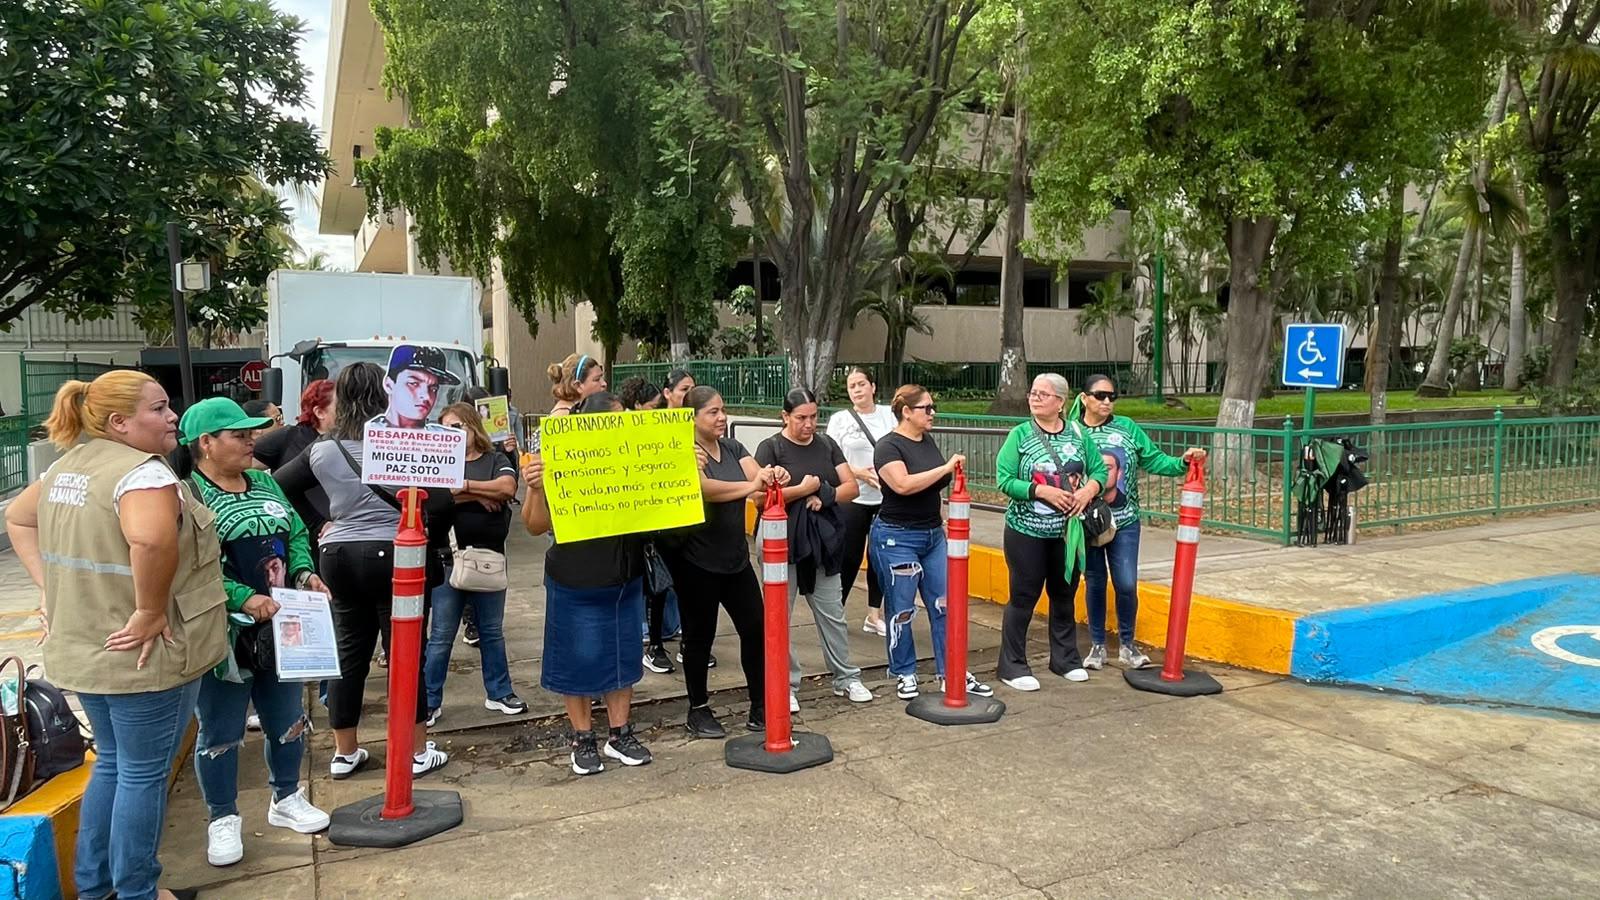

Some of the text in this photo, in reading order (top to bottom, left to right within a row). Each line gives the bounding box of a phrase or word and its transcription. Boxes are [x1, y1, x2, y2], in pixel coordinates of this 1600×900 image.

[244, 370, 263, 381] ALT
[544, 415, 624, 436] GOBERNADORA
[632, 413, 645, 426] DE
[368, 430, 461, 443] DESAPARECIDO
[619, 441, 629, 455] el
[637, 442, 665, 457] pago
[668, 437, 683, 450] de
[371, 452, 456, 465] MIGUEL DAVID
[385, 464, 440, 475] PAZ SOTO
[553, 461, 677, 486] pensiones y seguros
[54, 472, 90, 490] DERECHOS
[48, 487, 87, 507] HUMANOS
[558, 486, 574, 500] de
[553, 503, 569, 516] las
[573, 500, 615, 517] familias
[618, 500, 631, 509] no
